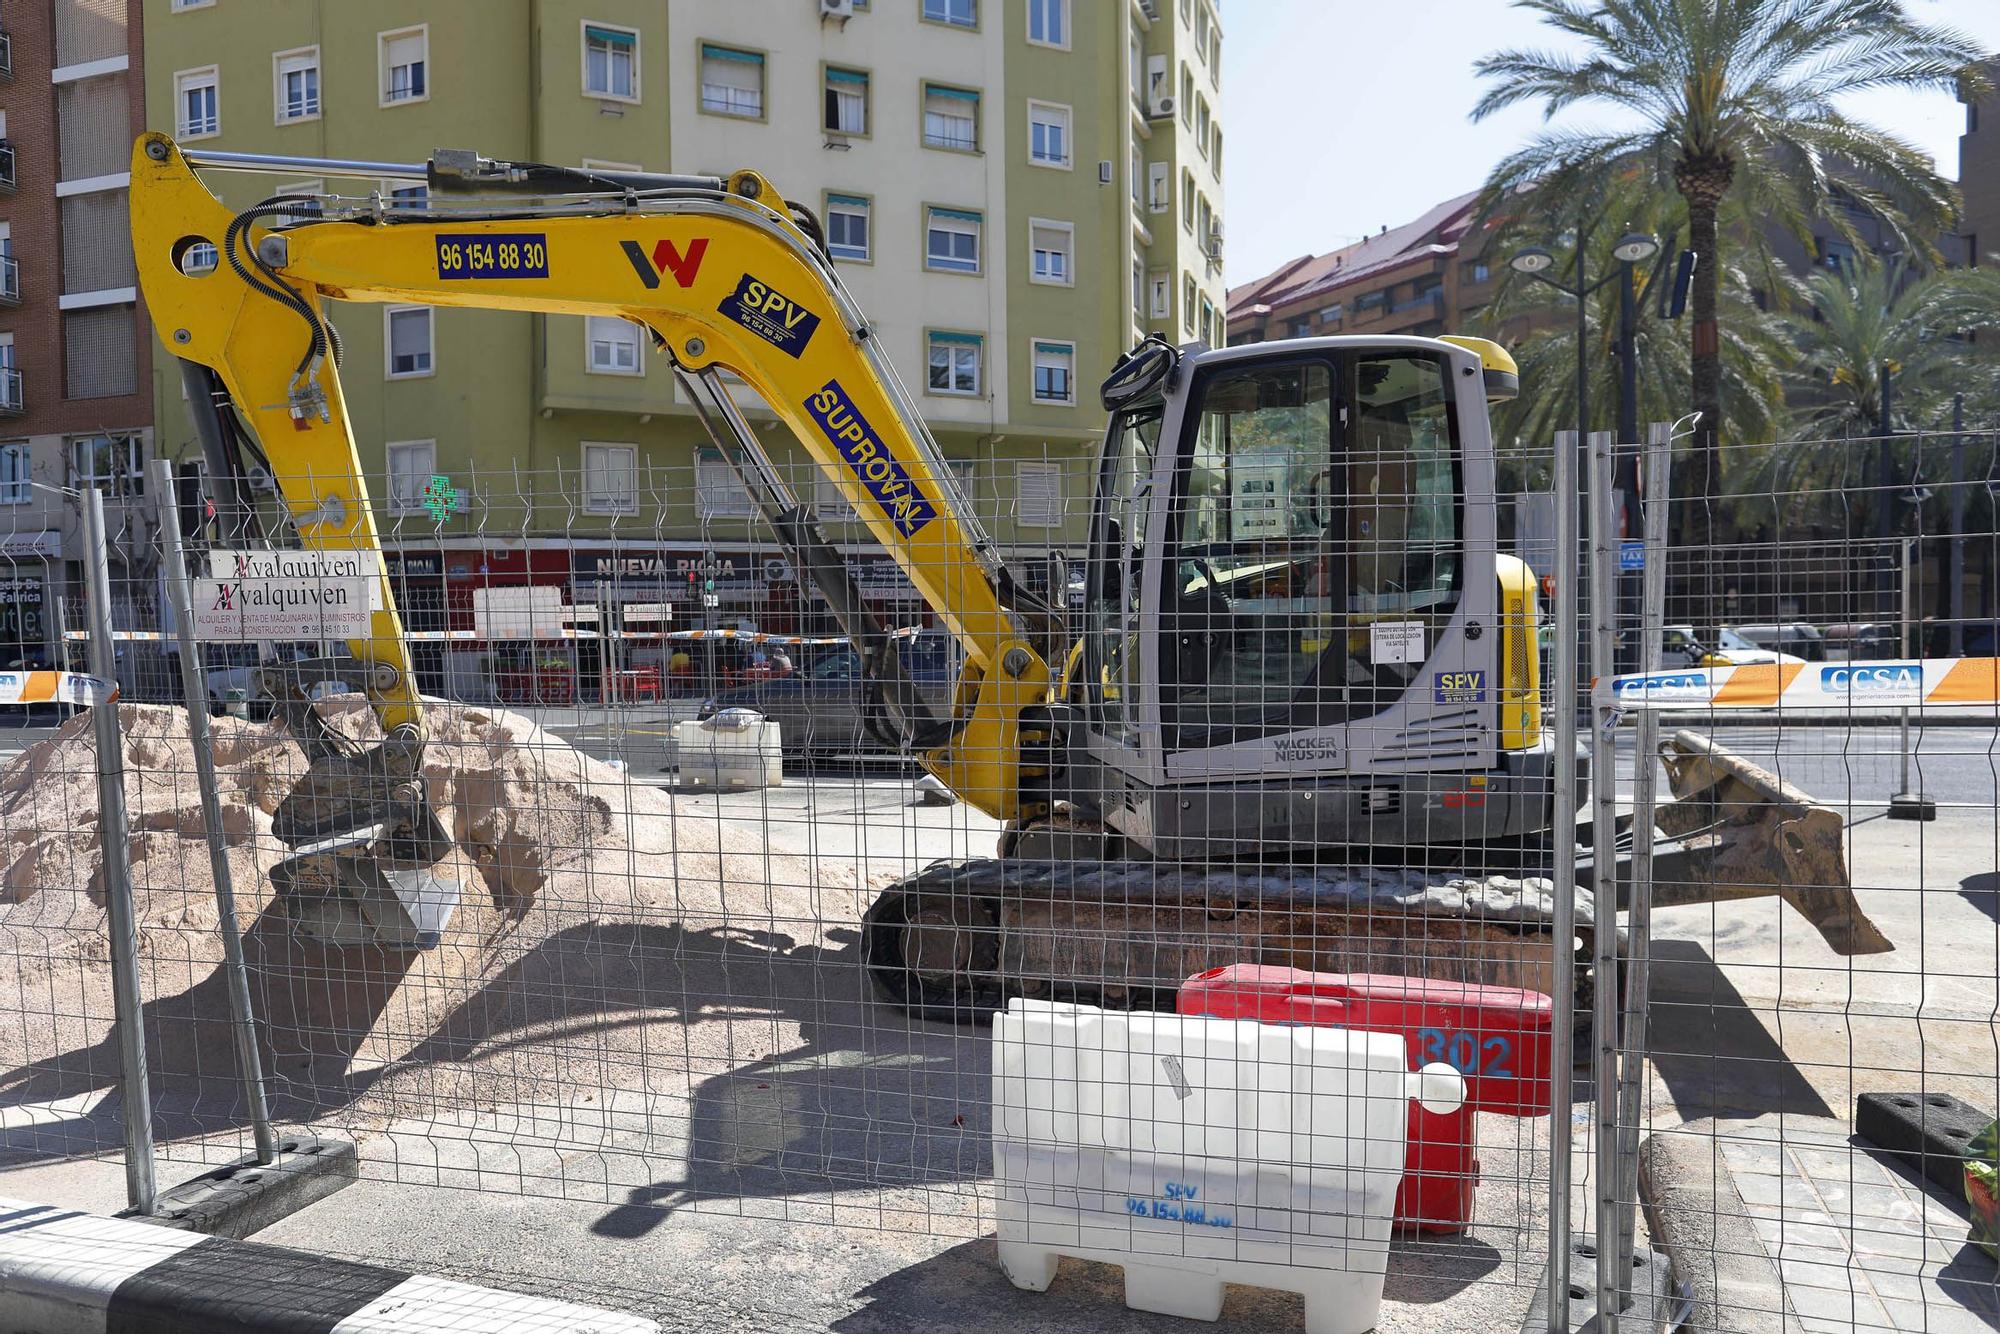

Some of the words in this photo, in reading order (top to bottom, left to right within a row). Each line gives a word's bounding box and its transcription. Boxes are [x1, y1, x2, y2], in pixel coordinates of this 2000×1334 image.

[441, 244, 462, 270] 96
[466, 244, 494, 270] 154
[499, 243, 519, 269] 88
[524, 243, 544, 269] 30
[743, 281, 807, 329] SPV
[741, 313, 751, 323] 96
[751, 318, 764, 331] 154
[773, 333, 783, 343] 30
[814, 389, 922, 531] SUPROVAL
[597, 558, 664, 577] NUEVA
[1, 592, 41, 603] Fabrica
[241, 582, 347, 611] valquiven
[636, 591, 672, 600] NUEA
[198, 614, 231, 623] ALQUILER
[233, 614, 238, 623] Y
[239, 614, 260, 623] VENTA
[260, 614, 269, 623] DE
[270, 613, 314, 623] MAQUINARIA
[314, 613, 319, 622] Y
[320, 613, 365, 622] SUMINISTROS
[215, 627, 232, 635] PARA
[312, 626, 320, 634] 96
[334, 626, 341, 634] 10
[1441, 672, 1480, 690] SPV
[1830, 668, 1916, 691] CCSA
[1273, 737, 1336, 750] WACKER
[1275, 749, 1337, 762] NEUSON
[1417, 1027, 1512, 1077] 302
[1165, 1182, 1197, 1199] SPV
